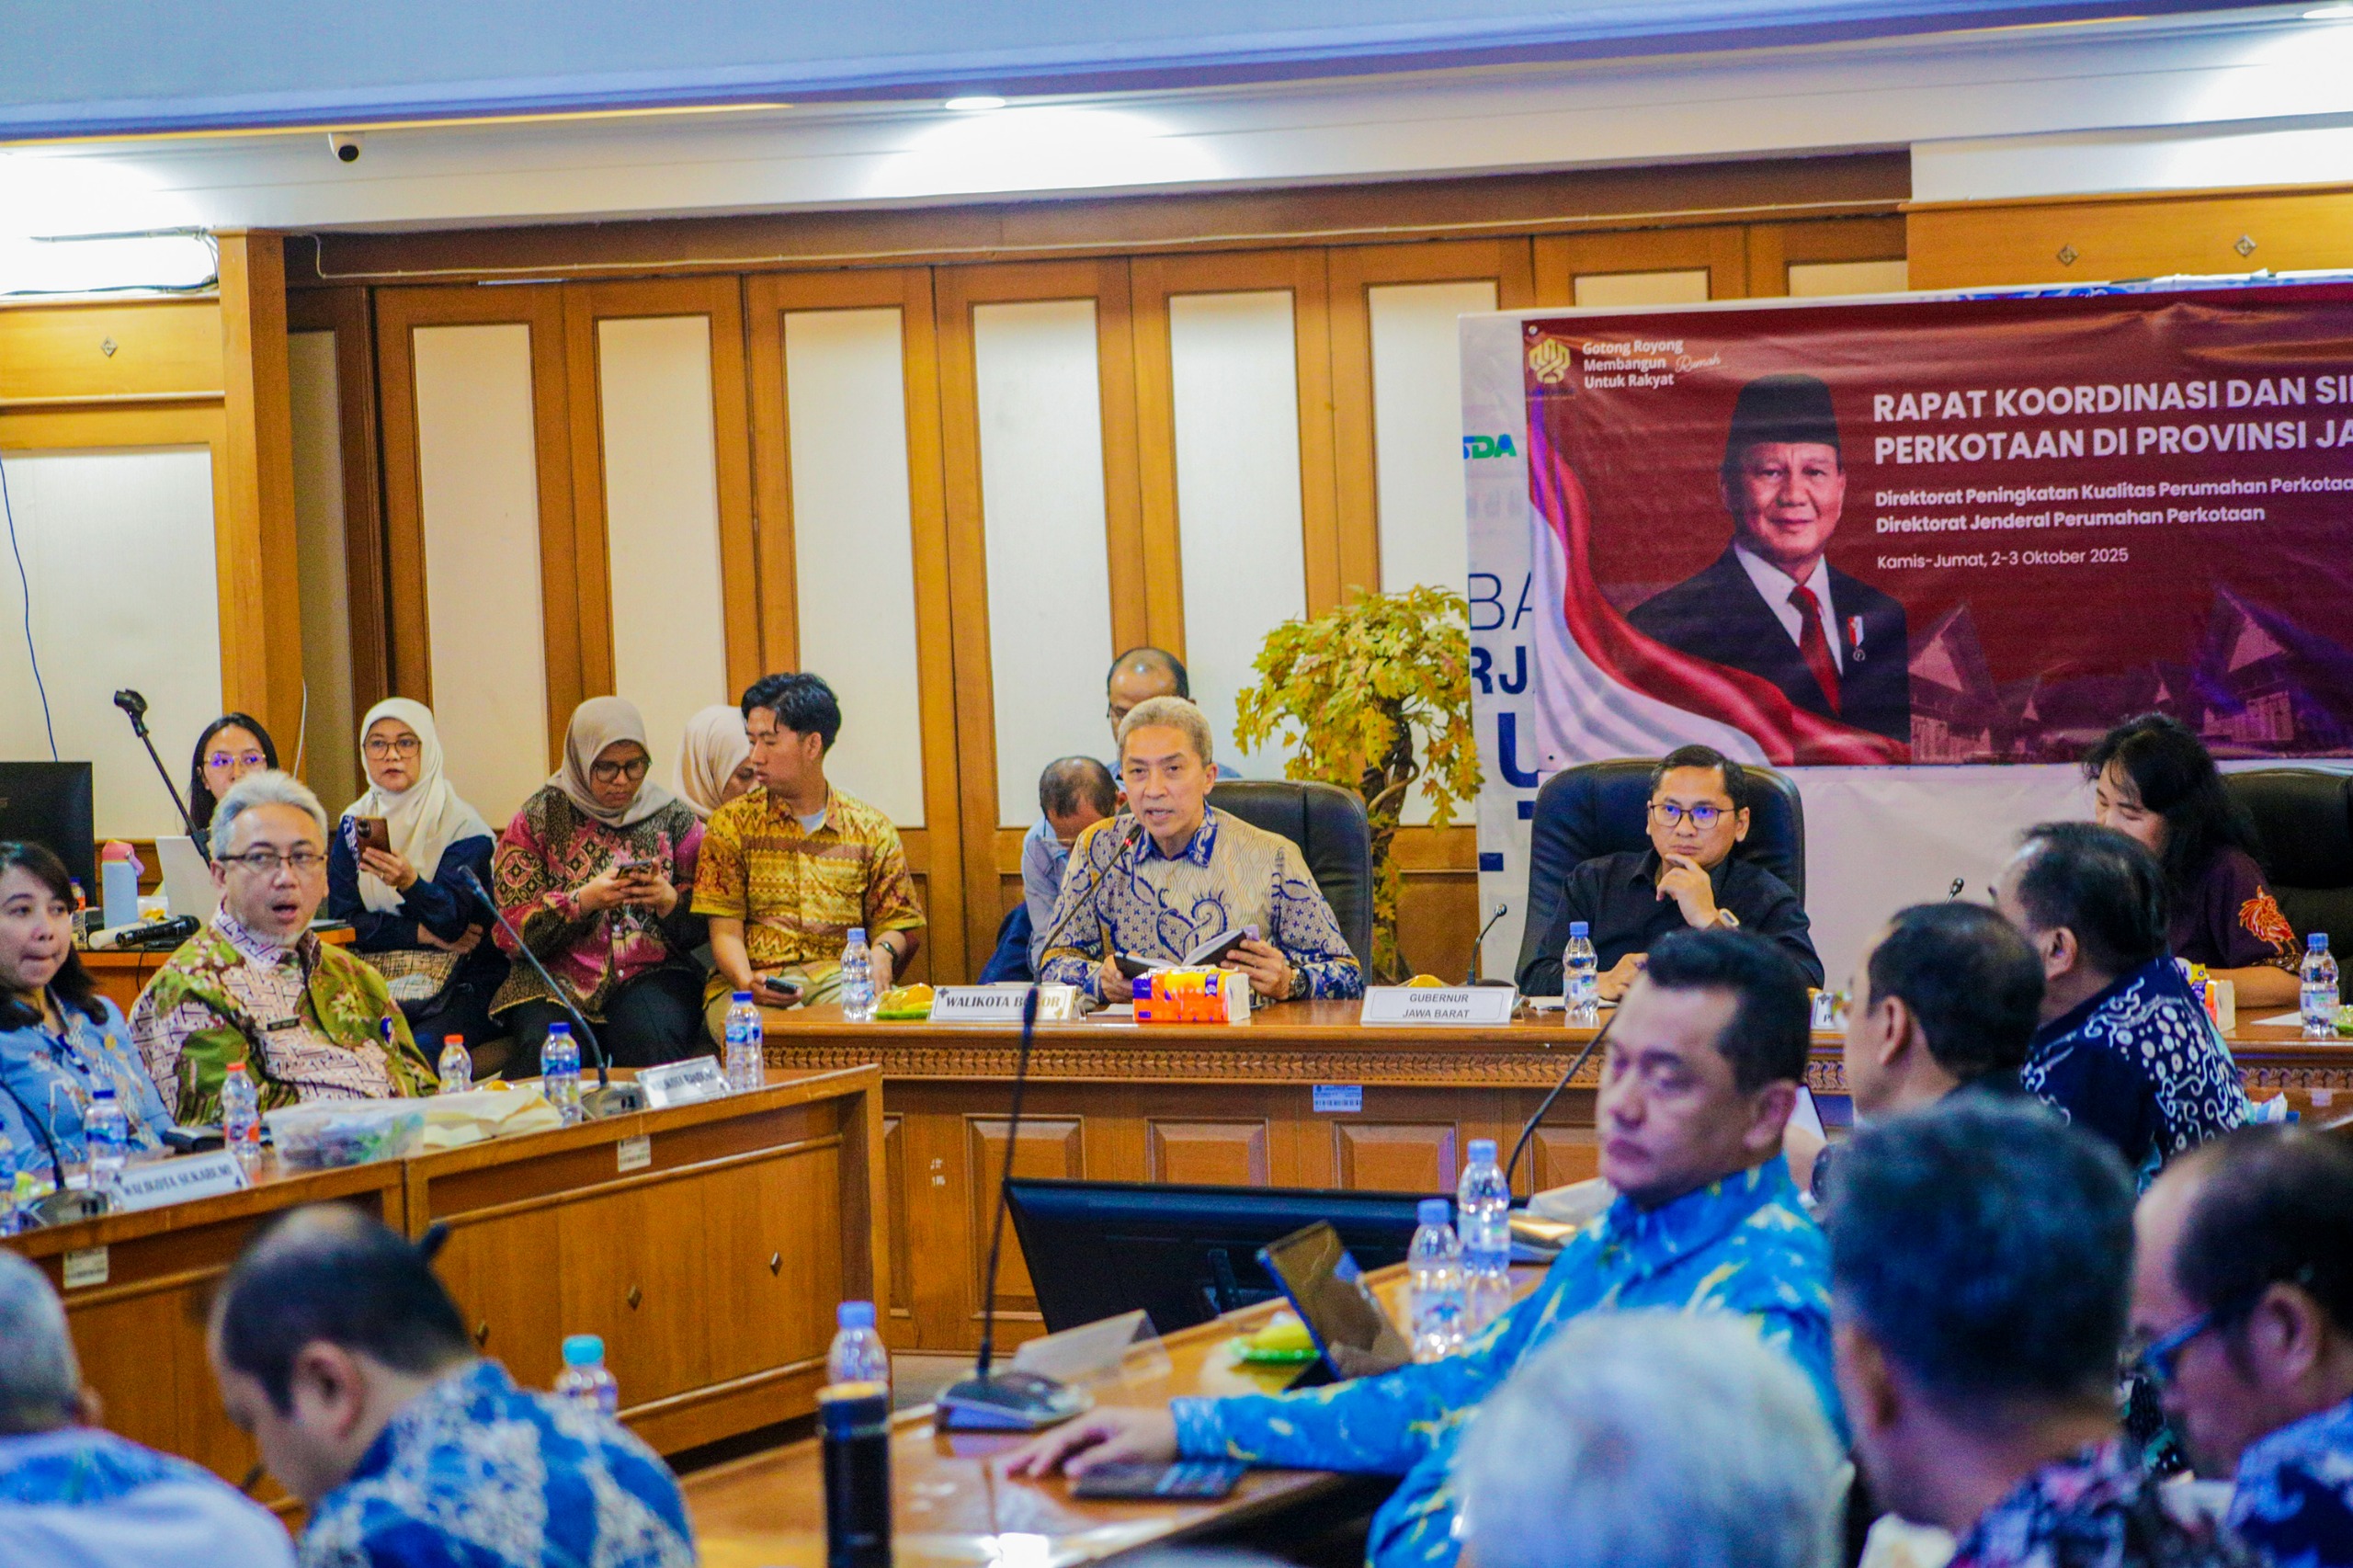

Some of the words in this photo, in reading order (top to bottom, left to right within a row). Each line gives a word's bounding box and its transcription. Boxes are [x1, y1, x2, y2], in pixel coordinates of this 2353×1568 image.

[1582, 341, 1631, 357] Gotong
[1633, 339, 1684, 355] Royong
[1584, 357, 1666, 372] Membangun
[1675, 352, 1721, 372] Rumah
[1584, 375, 1625, 389] Untuk
[1628, 373, 1675, 389] Rakyat
[1873, 390, 1987, 422] RAPAT
[1995, 381, 2218, 417] KOORDINASI
[2227, 377, 2306, 408] DAN
[2315, 374, 2353, 404] SI
[1875, 428, 2085, 465] PERKOTAAN
[2093, 427, 2128, 457] DI
[2136, 420, 2307, 455] PROVINSI
[2315, 418, 2353, 449] JA
[1875, 489, 1963, 506] Direktorat
[1965, 486, 2078, 506] Peningkatan
[2081, 482, 2156, 500] Kualitas
[2159, 478, 2268, 497] Perumahan
[2270, 476, 2353, 494] Perkotaa
[1876, 515, 1967, 533] Direktorat
[1970, 511, 2051, 530] Jenderal
[2053, 508, 2164, 528] Perumahan
[2166, 506, 2266, 524] Perkotaan
[1877, 553, 1988, 569] Kamis-Jumat,
[1991, 551, 2019, 566] 2-3
[2022, 549, 2086, 564] Oktober
[2090, 547, 2129, 562] 2025
[946, 995, 1010, 1008] WALIKOTA
[1014, 995, 1061, 1008] BOR
[1409, 993, 1470, 1003] GUBERNUR
[1403, 1008, 1431, 1018] JAWA
[1434, 1008, 1471, 1018] BARAT
